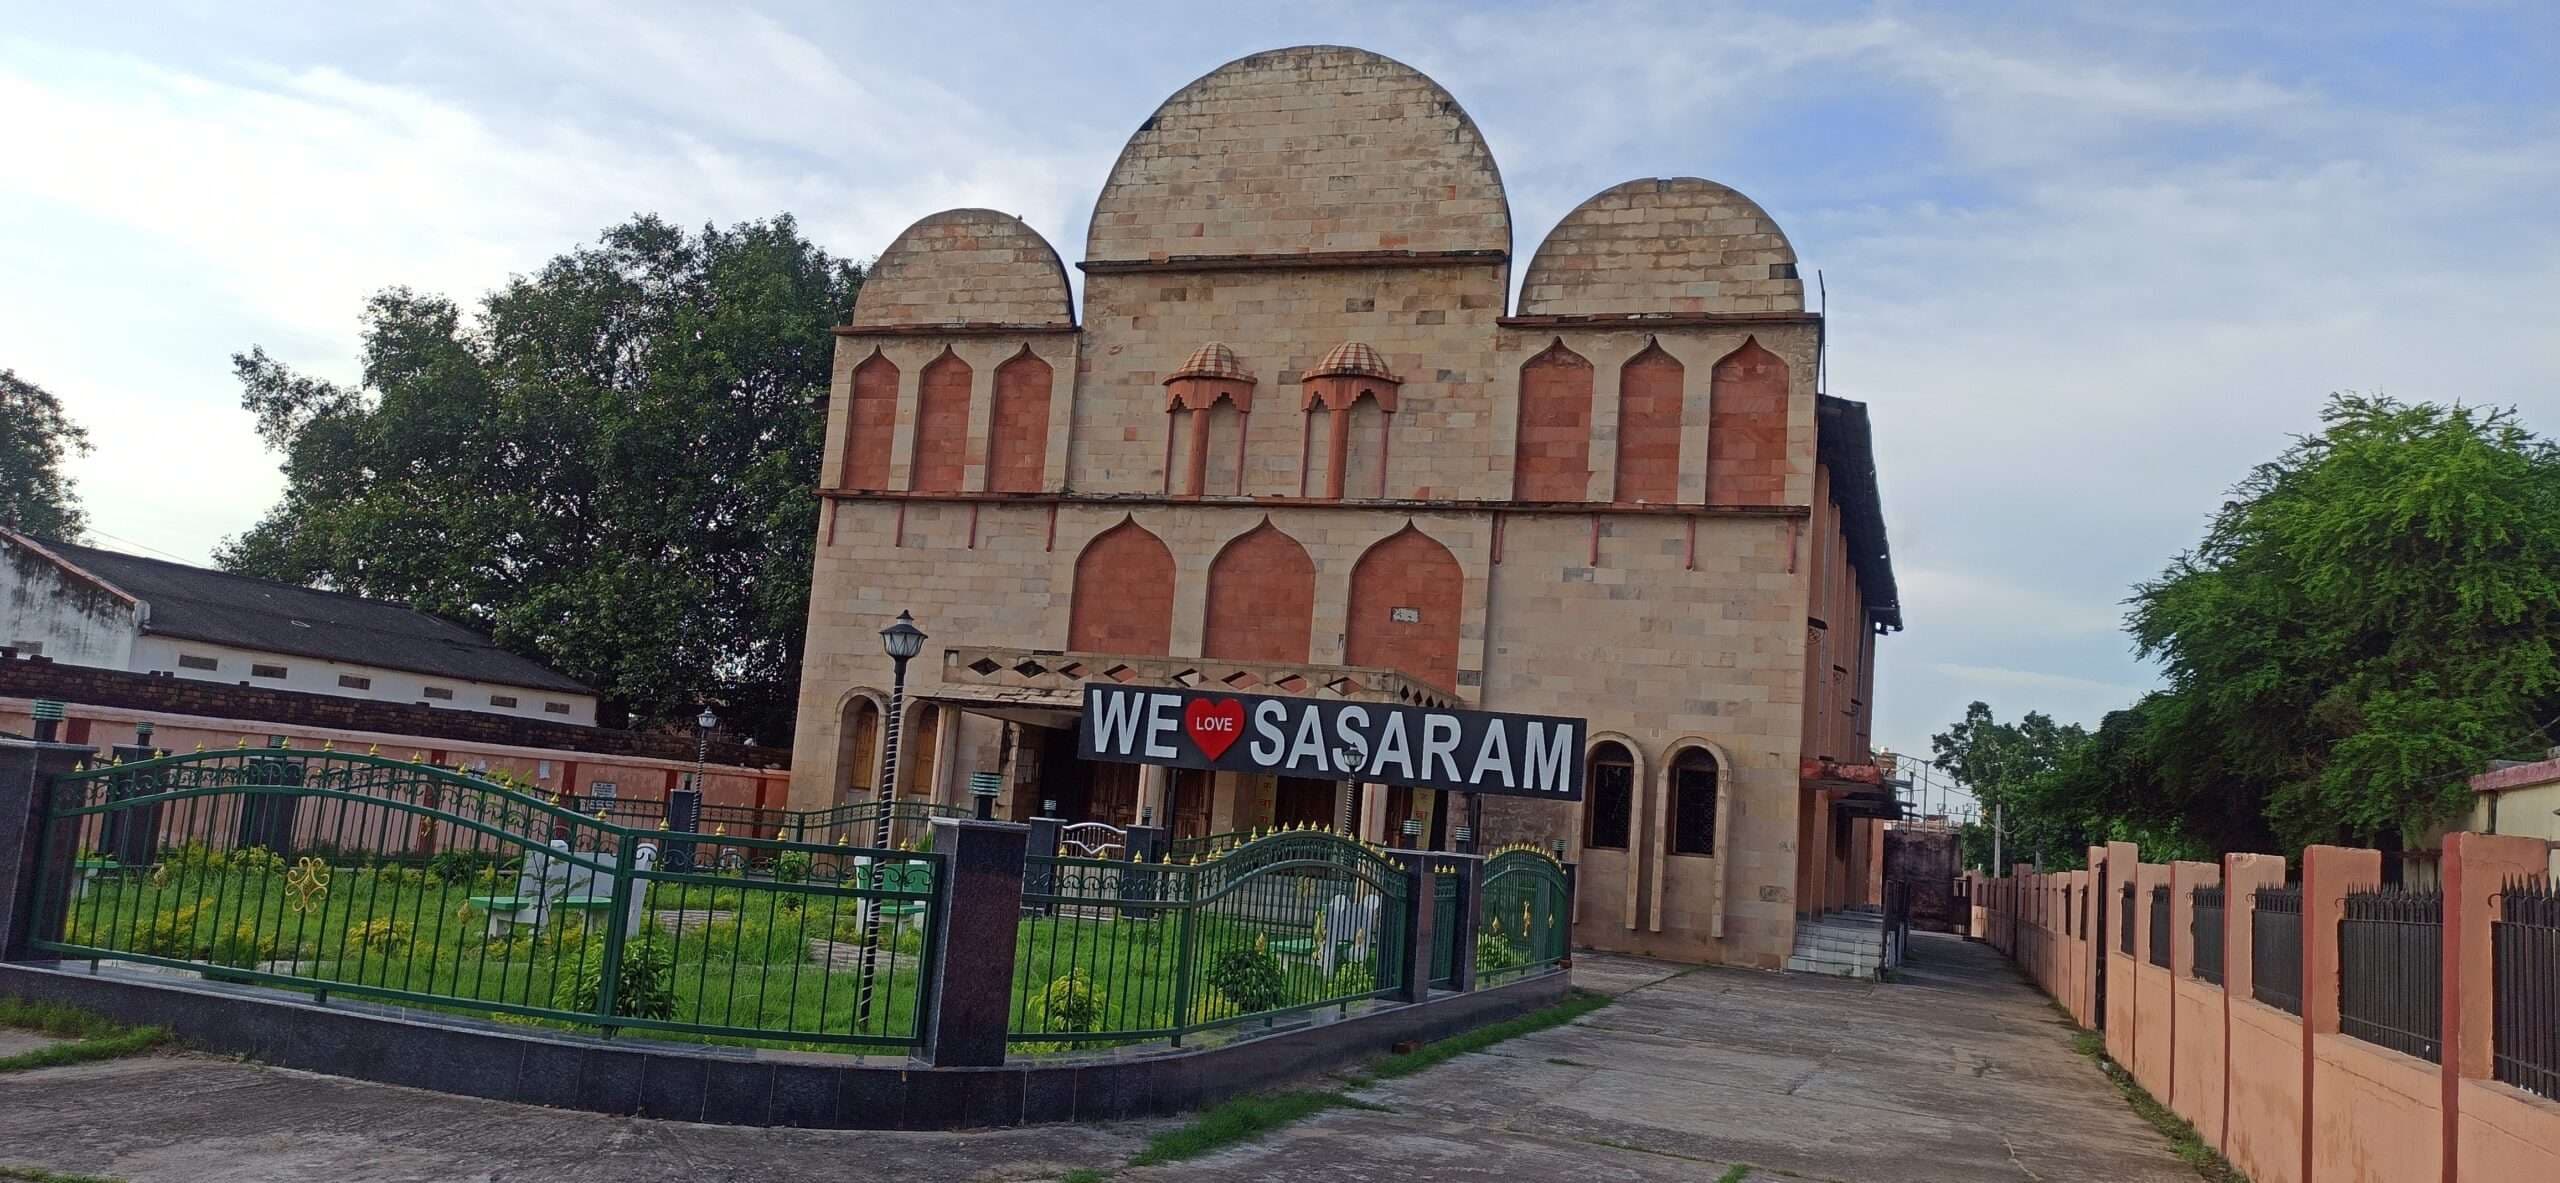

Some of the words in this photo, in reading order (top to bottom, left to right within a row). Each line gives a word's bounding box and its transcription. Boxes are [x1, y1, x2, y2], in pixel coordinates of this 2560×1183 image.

[1092, 689, 1182, 758] WE
[1196, 716, 1233, 732] LOVE
[1250, 699, 1573, 792] SASARAM
